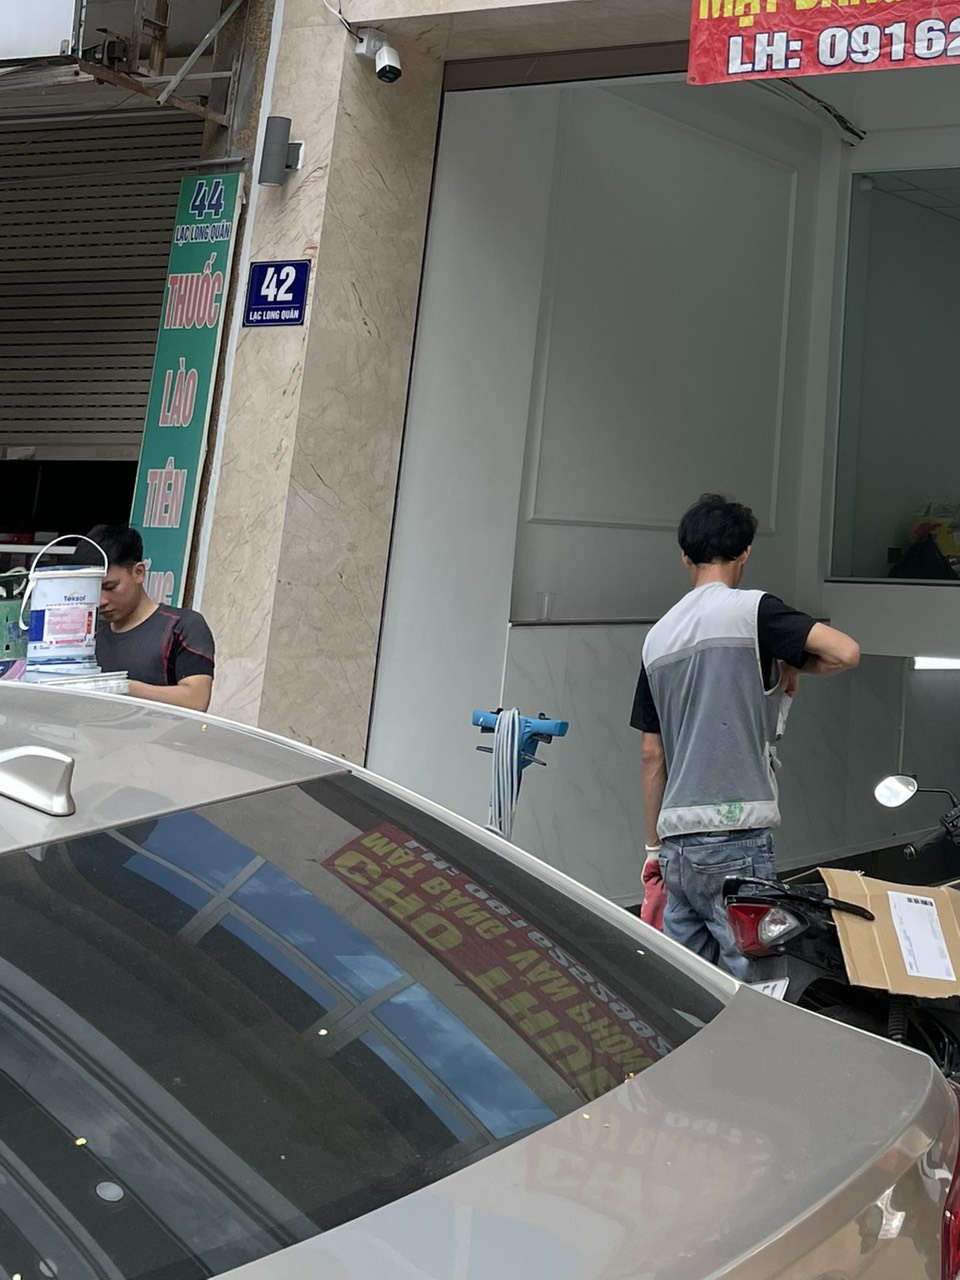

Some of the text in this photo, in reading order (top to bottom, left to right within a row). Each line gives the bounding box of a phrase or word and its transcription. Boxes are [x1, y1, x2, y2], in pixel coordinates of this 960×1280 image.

[726, 31, 803, 75] LH:
[189, 179, 224, 219] 44
[174, 219, 231, 246] LẠC LONG QUÂN
[164, 253, 223, 329] THUỐC
[260, 266, 296, 302] 42
[249, 308, 299, 322] LẠC LONG QUÂN
[159, 357, 198, 427] LÀO
[143, 456, 187, 528] TIÊN
